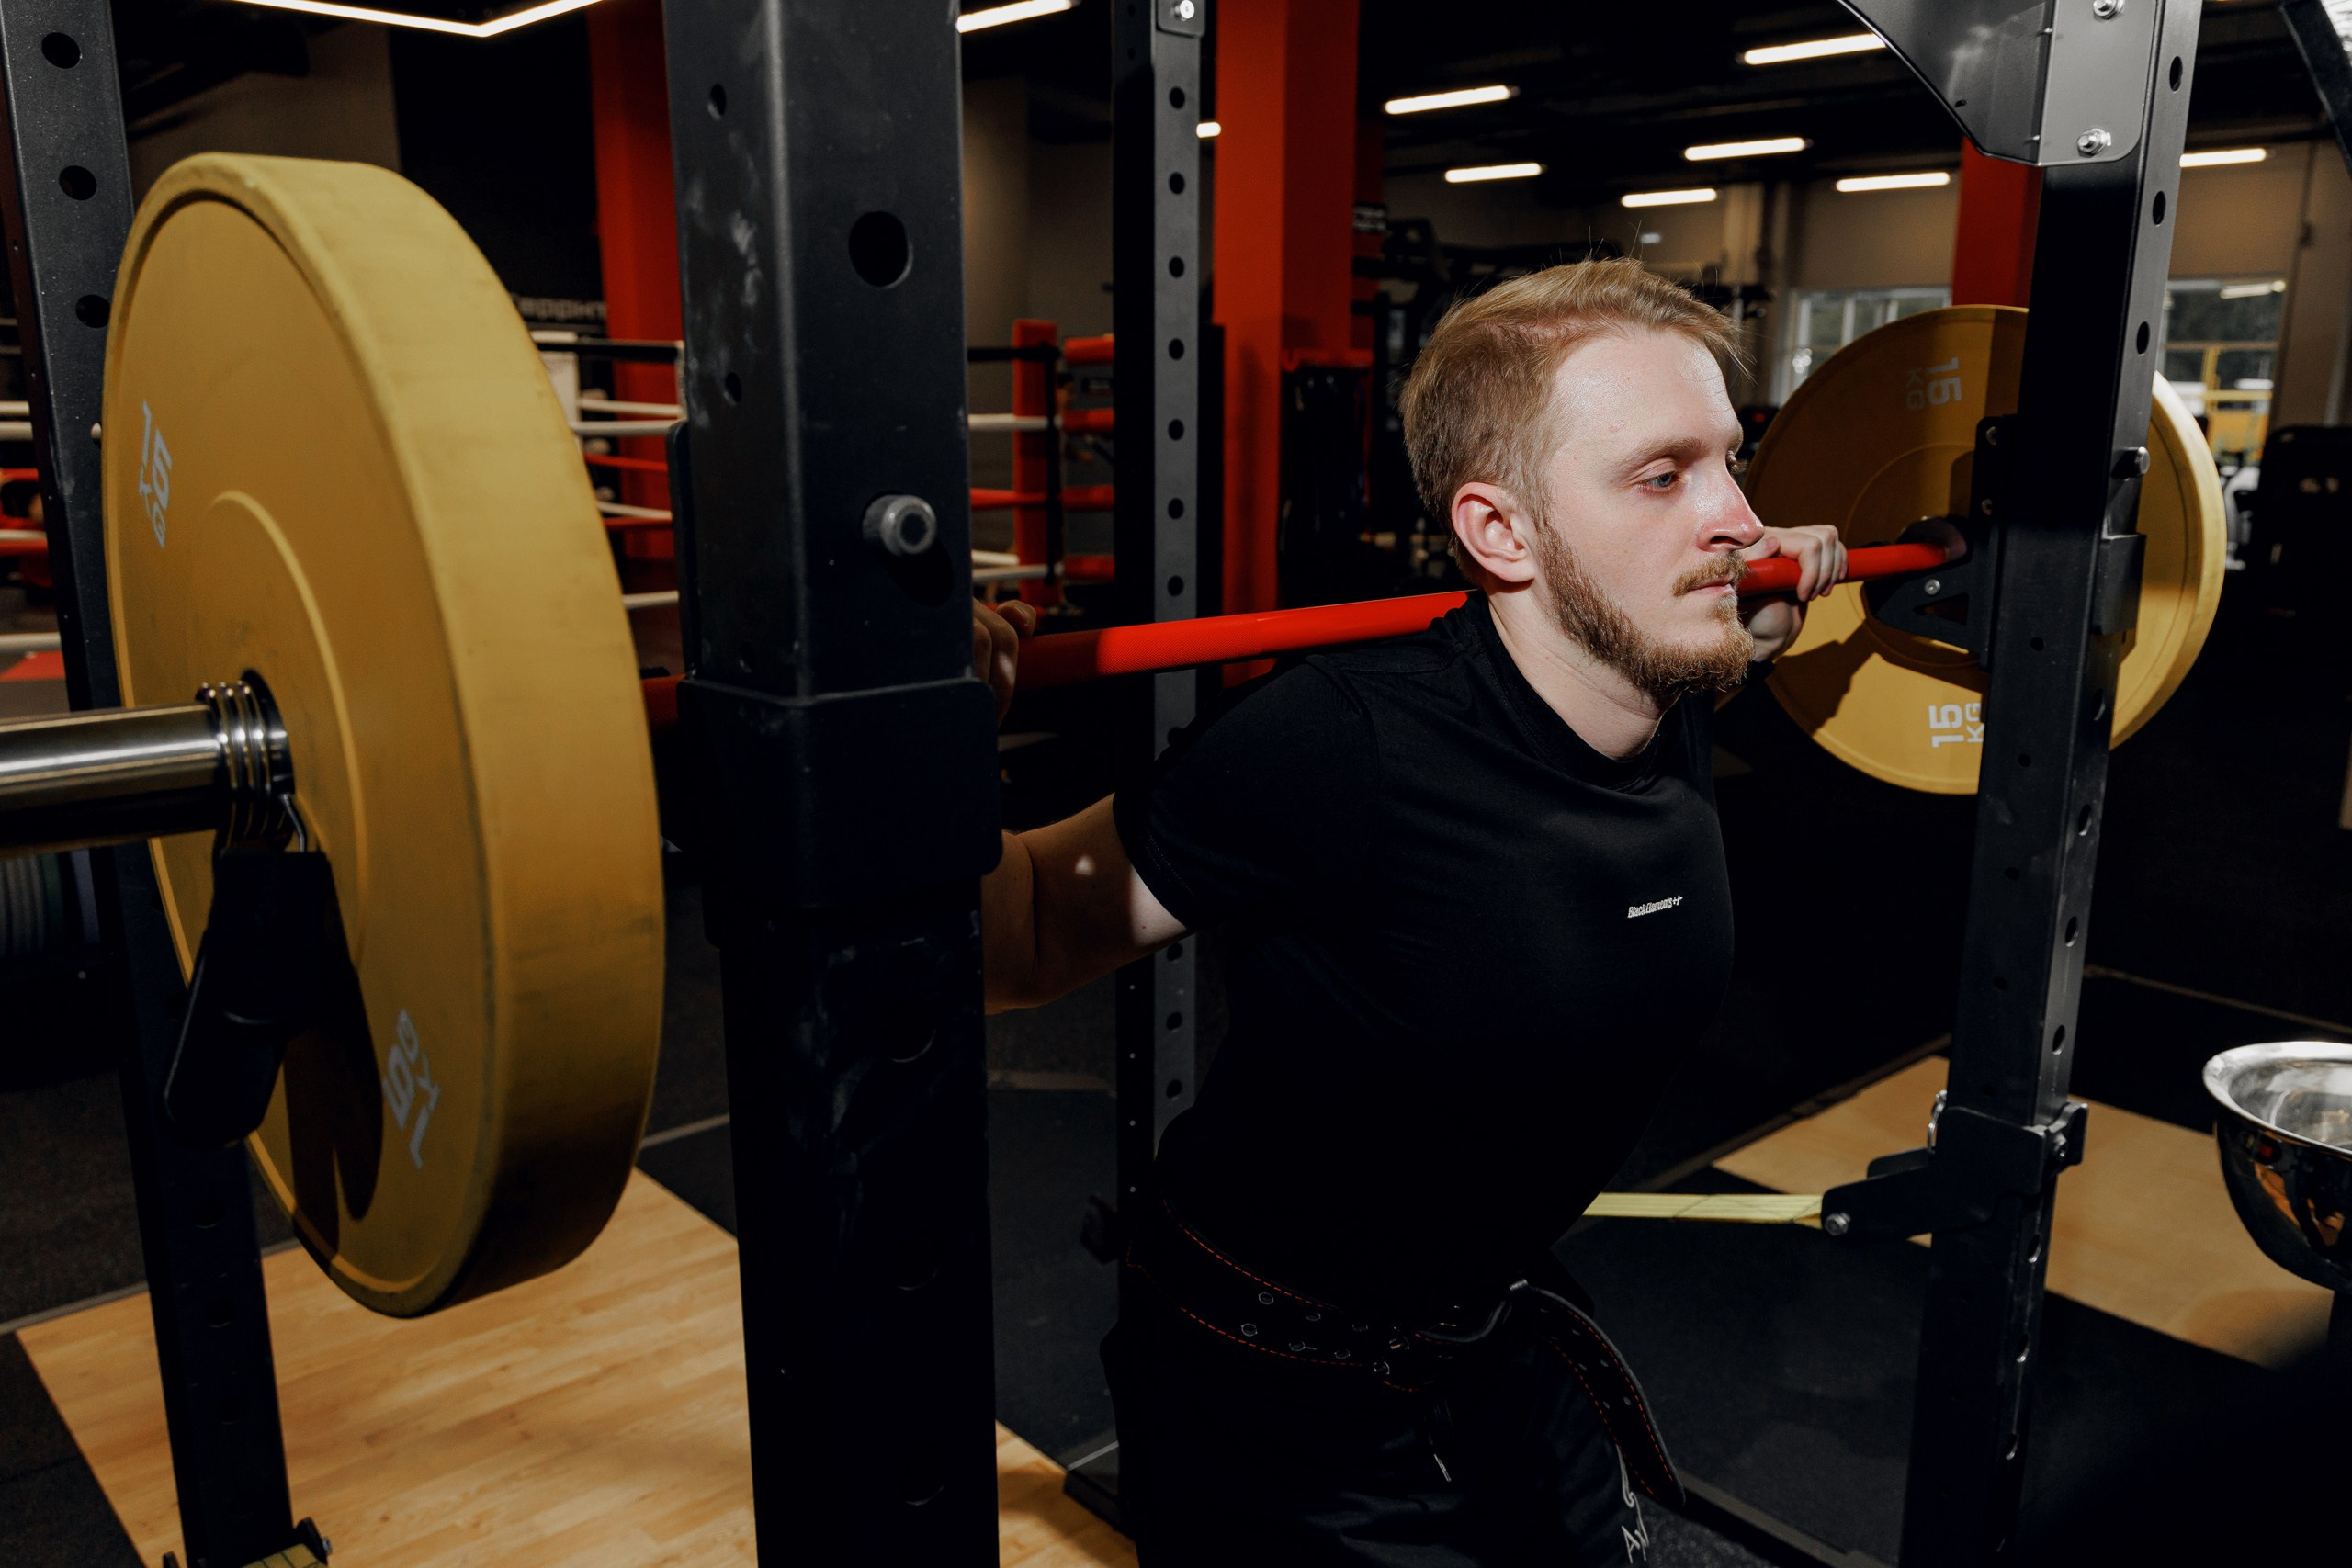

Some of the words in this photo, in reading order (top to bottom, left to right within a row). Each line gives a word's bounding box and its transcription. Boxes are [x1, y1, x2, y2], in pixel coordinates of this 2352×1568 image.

[1905, 367, 1925, 410] KG
[1925, 355, 1962, 405] 15
[141, 400, 173, 511] 15
[138, 462, 166, 549] KG
[1928, 704, 1964, 748] 15
[1965, 702, 1984, 742] KG
[1627, 904, 1645, 918] Black
[397, 1009, 441, 1113] KG
[382, 1043, 424, 1171] 15
